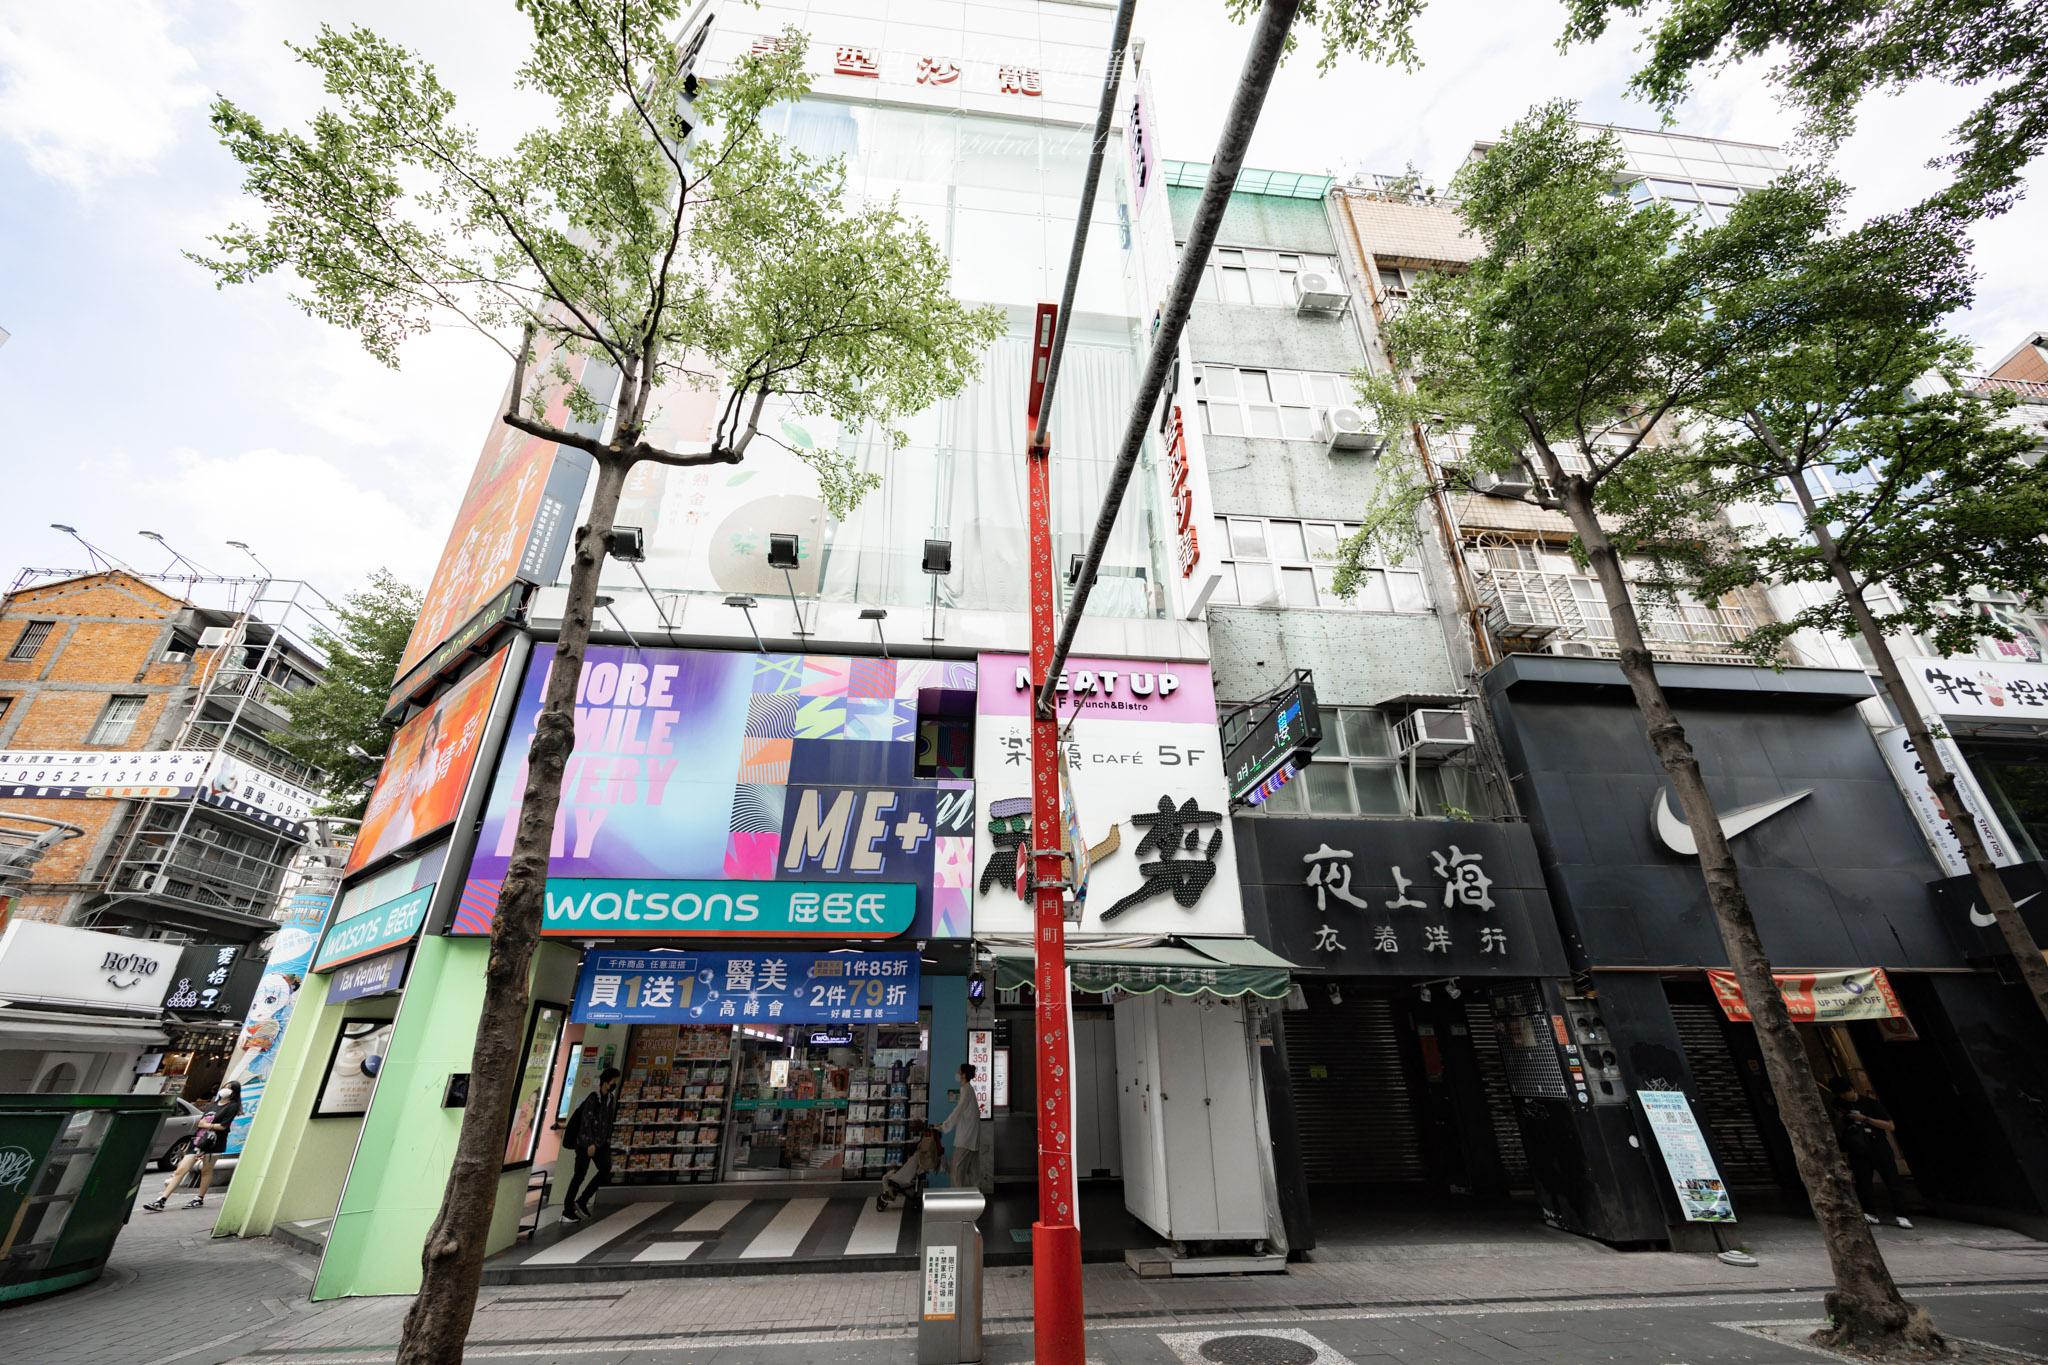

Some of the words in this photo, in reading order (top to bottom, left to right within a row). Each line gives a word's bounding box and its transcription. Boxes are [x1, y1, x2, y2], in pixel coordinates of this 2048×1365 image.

[1130, 672, 1180, 696] UP
[529, 706, 681, 755] MILE
[1092, 751, 1144, 765] CAFÉ
[1158, 744, 1206, 766] 5F
[784, 788, 932, 874] ME+
[1977, 817, 1995, 840] SINCE
[1303, 843, 1496, 912] 夜上海
[545, 888, 760, 923] watsons
[788, 892, 887, 924] 屈臣氏
[324, 915, 384, 958] watsons
[338, 970, 356, 992] Tax
[354, 960, 388, 988] Refund
[725, 958, 788, 992] 醫美
[844, 959, 909, 977] 1件85折
[588, 975, 695, 1009] 買1送1
[809, 979, 907, 1007] 2件79折
[1818, 997, 1831, 1007] UP
[1833, 997, 1846, 1007] TO
[1863, 996, 1882, 1005] OFF
[720, 999, 785, 1017] 高峰會
[973, 1053, 989, 1063] 350
